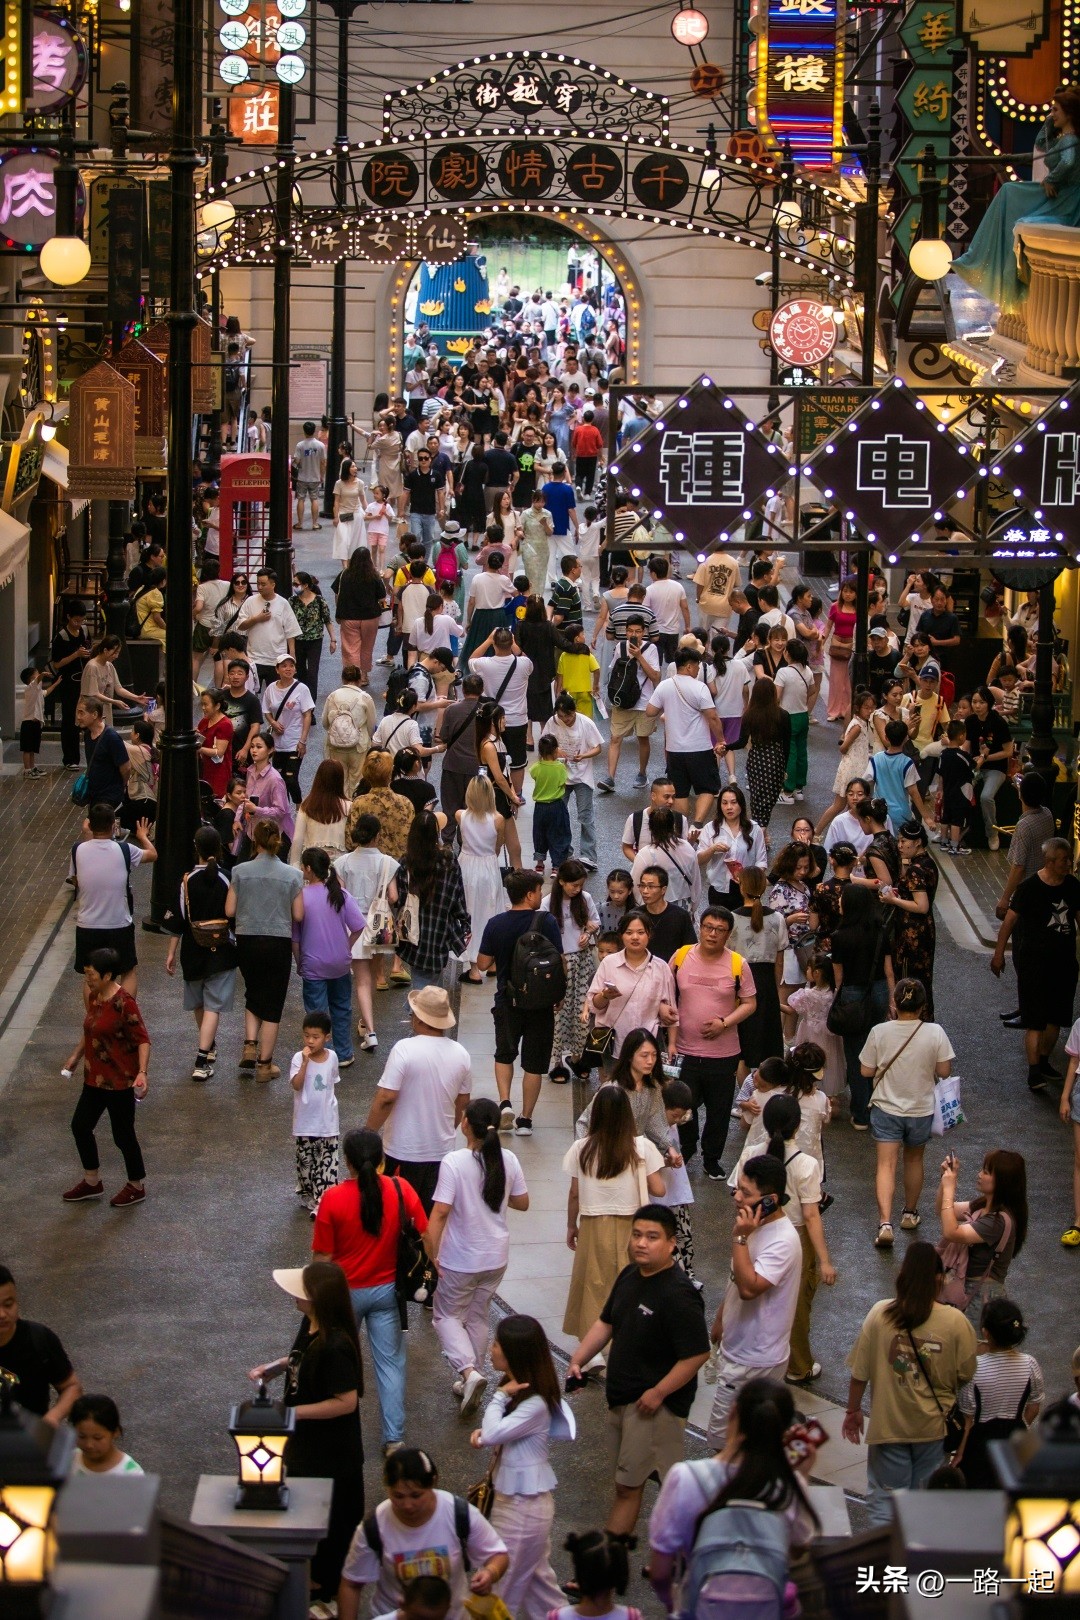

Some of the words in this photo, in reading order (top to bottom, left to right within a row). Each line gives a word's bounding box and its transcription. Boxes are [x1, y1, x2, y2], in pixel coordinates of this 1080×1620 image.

[676, 17, 706, 37] 記
[820, 395, 845, 404] NIAN
[847, 395, 860, 403] HE
[801, 404, 860, 413] DISENSARY
[233, 478, 271, 487] TELEPHO
